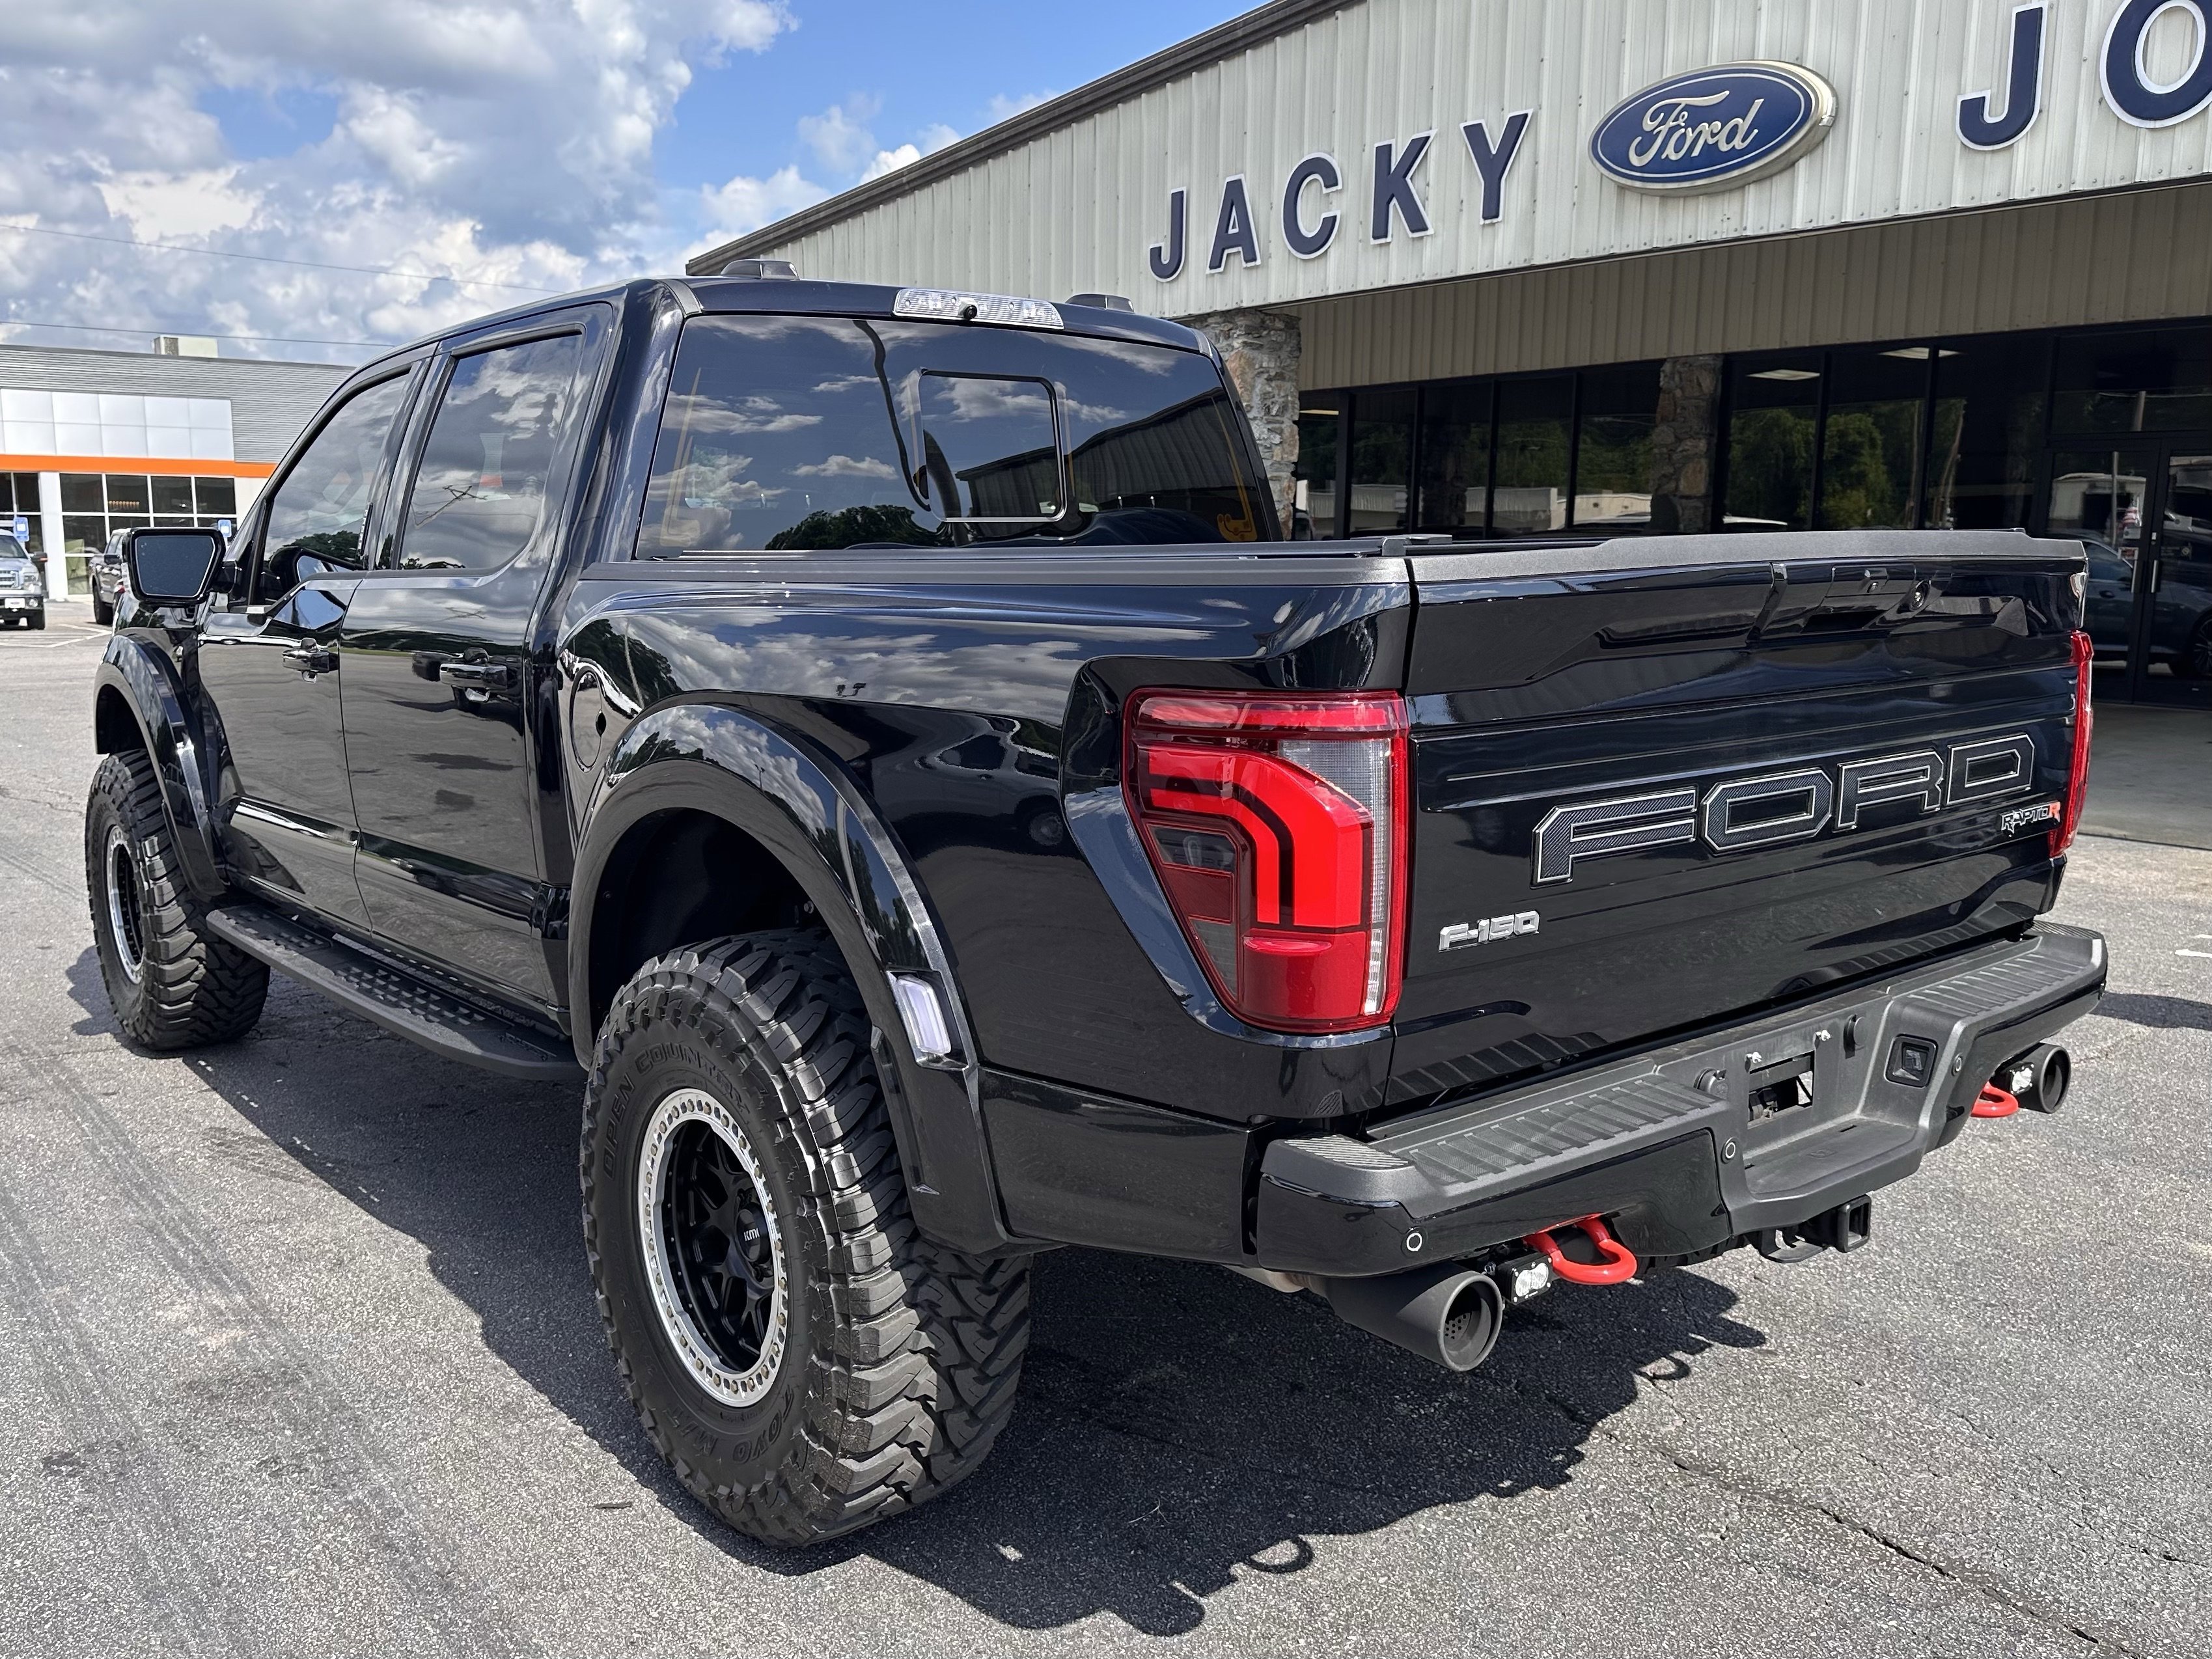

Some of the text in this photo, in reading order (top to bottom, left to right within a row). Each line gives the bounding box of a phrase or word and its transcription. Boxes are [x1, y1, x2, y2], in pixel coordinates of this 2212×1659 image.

[1628, 90, 1765, 167] Ford
[1150, 109, 1534, 282] JACKY
[1532, 733, 2035, 886] FORD
[2000, 801, 2061, 834] RAPTOR
[1439, 910, 1541, 951] F-150
[603, 1073, 636, 1181] OPEN
[732, 1384, 795, 1465] TOYO
